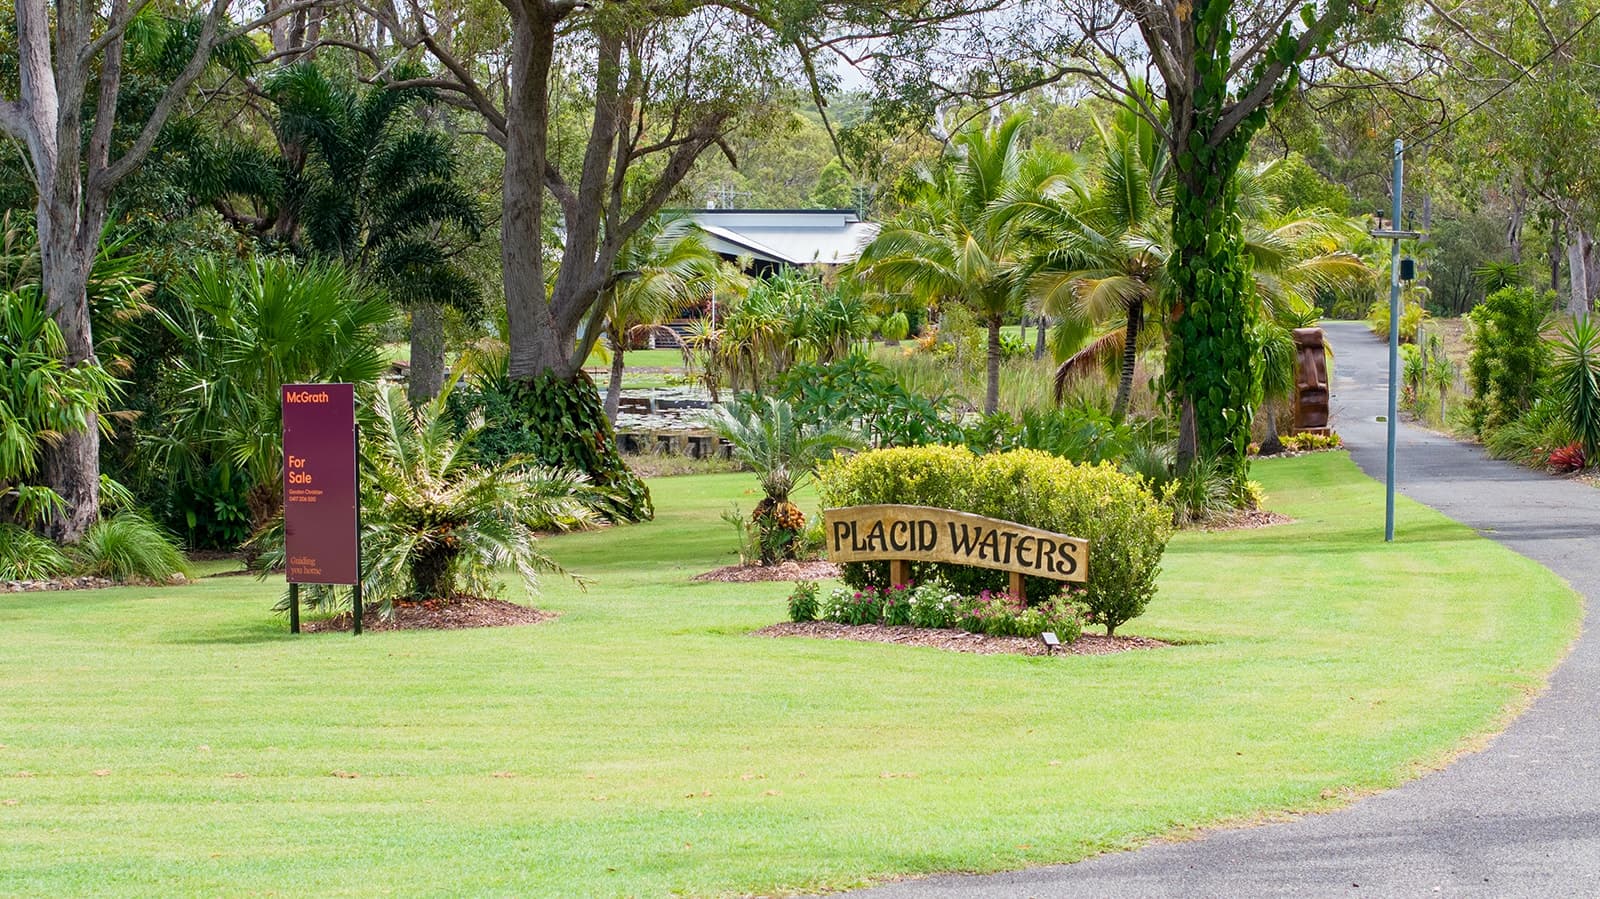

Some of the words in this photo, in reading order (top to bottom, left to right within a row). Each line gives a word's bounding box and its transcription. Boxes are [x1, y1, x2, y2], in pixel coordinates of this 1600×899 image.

[286, 391, 329, 403] McGrath
[288, 455, 306, 468] For
[288, 471, 312, 484] Sale
[833, 520, 938, 552] PLACID
[948, 521, 1077, 575] WATERS
[290, 556, 316, 567] Guiding
